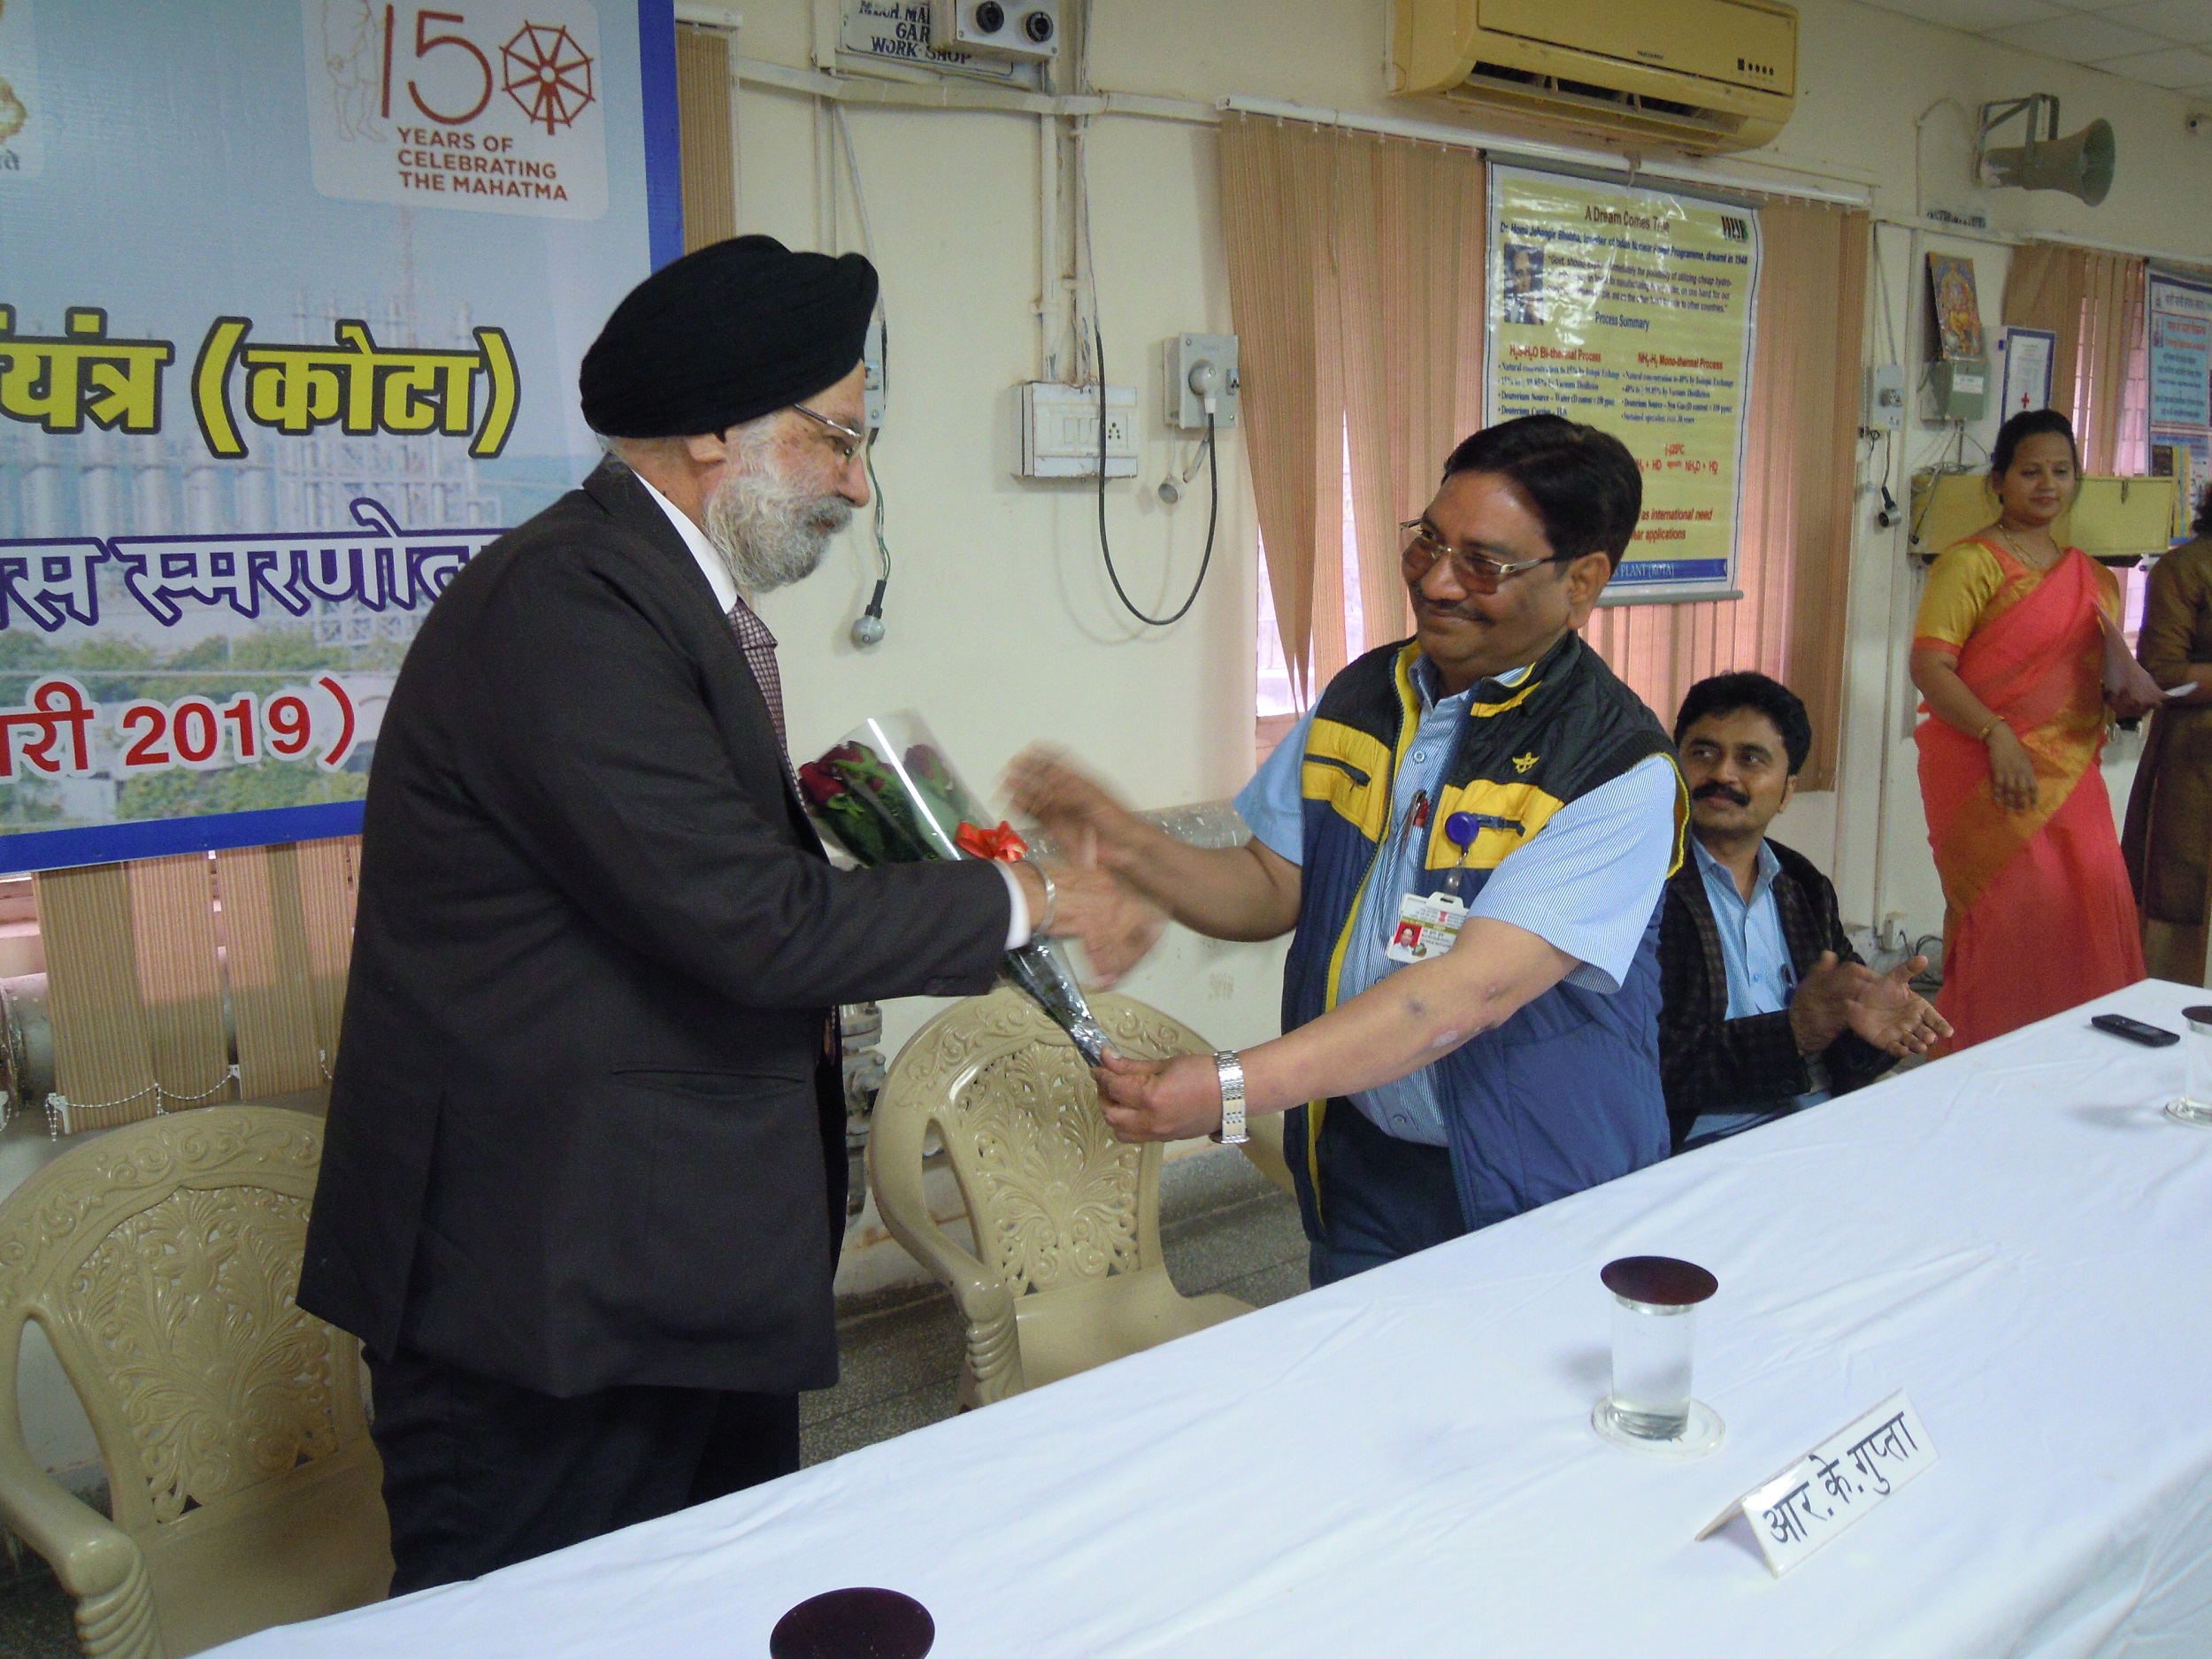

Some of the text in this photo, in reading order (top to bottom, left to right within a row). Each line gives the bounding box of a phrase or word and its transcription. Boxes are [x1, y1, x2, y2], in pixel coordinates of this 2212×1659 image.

[895, 22, 931, 42] GAR
[397, 126, 513, 153] YEARS OF
[398, 150, 557, 180] CELEBRATING
[399, 171, 568, 202] THE MAHATMA
[1585, 204, 1592, 221] A
[1594, 206, 1621, 226] Dream
[1623, 210, 1651, 230] Comes
[1595, 311, 1649, 332] Process Summary
[191, 316, 520, 458] (कोटा)
[1695, 507, 1714, 521] need
[1646, 528, 1686, 544] applications
[1621, 563, 1646, 578] PLANT
[125, 676, 354, 765] 2019)
